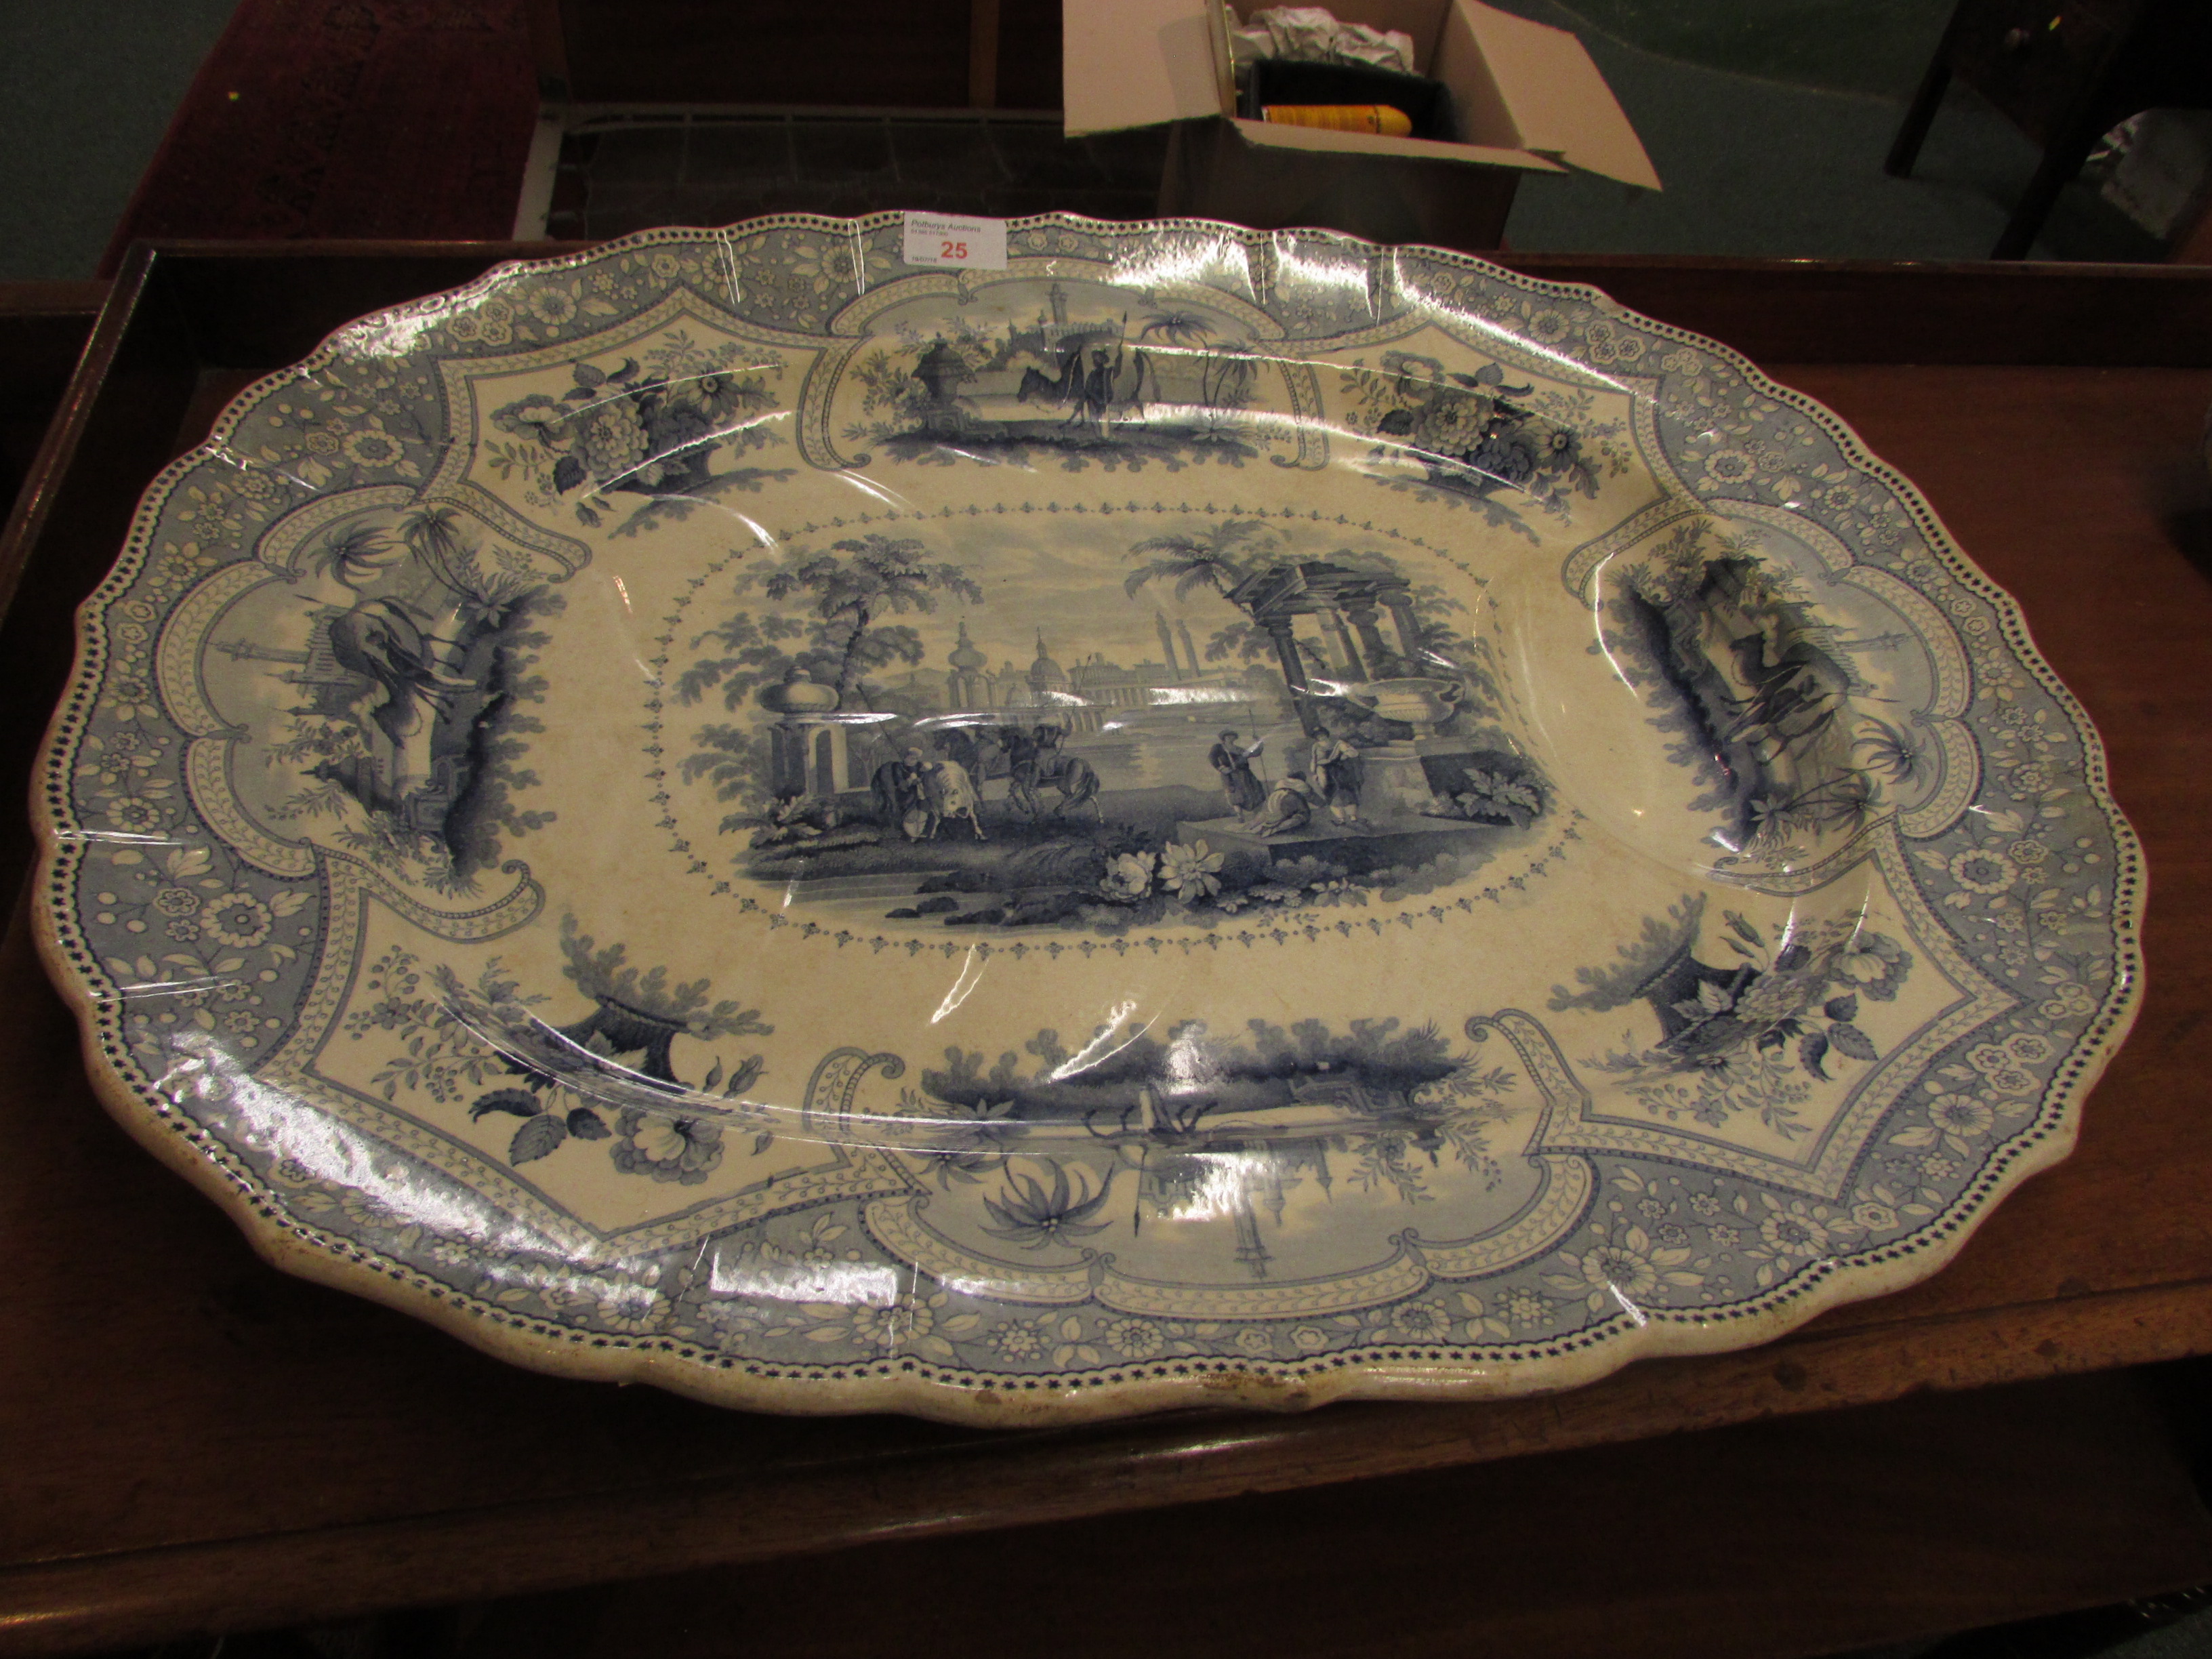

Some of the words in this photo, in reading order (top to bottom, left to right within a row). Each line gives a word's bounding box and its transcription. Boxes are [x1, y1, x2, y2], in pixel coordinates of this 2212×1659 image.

[911, 220, 945, 230] Potburys
[947, 223, 981, 233] Auctions
[941, 241, 968, 260] 25
